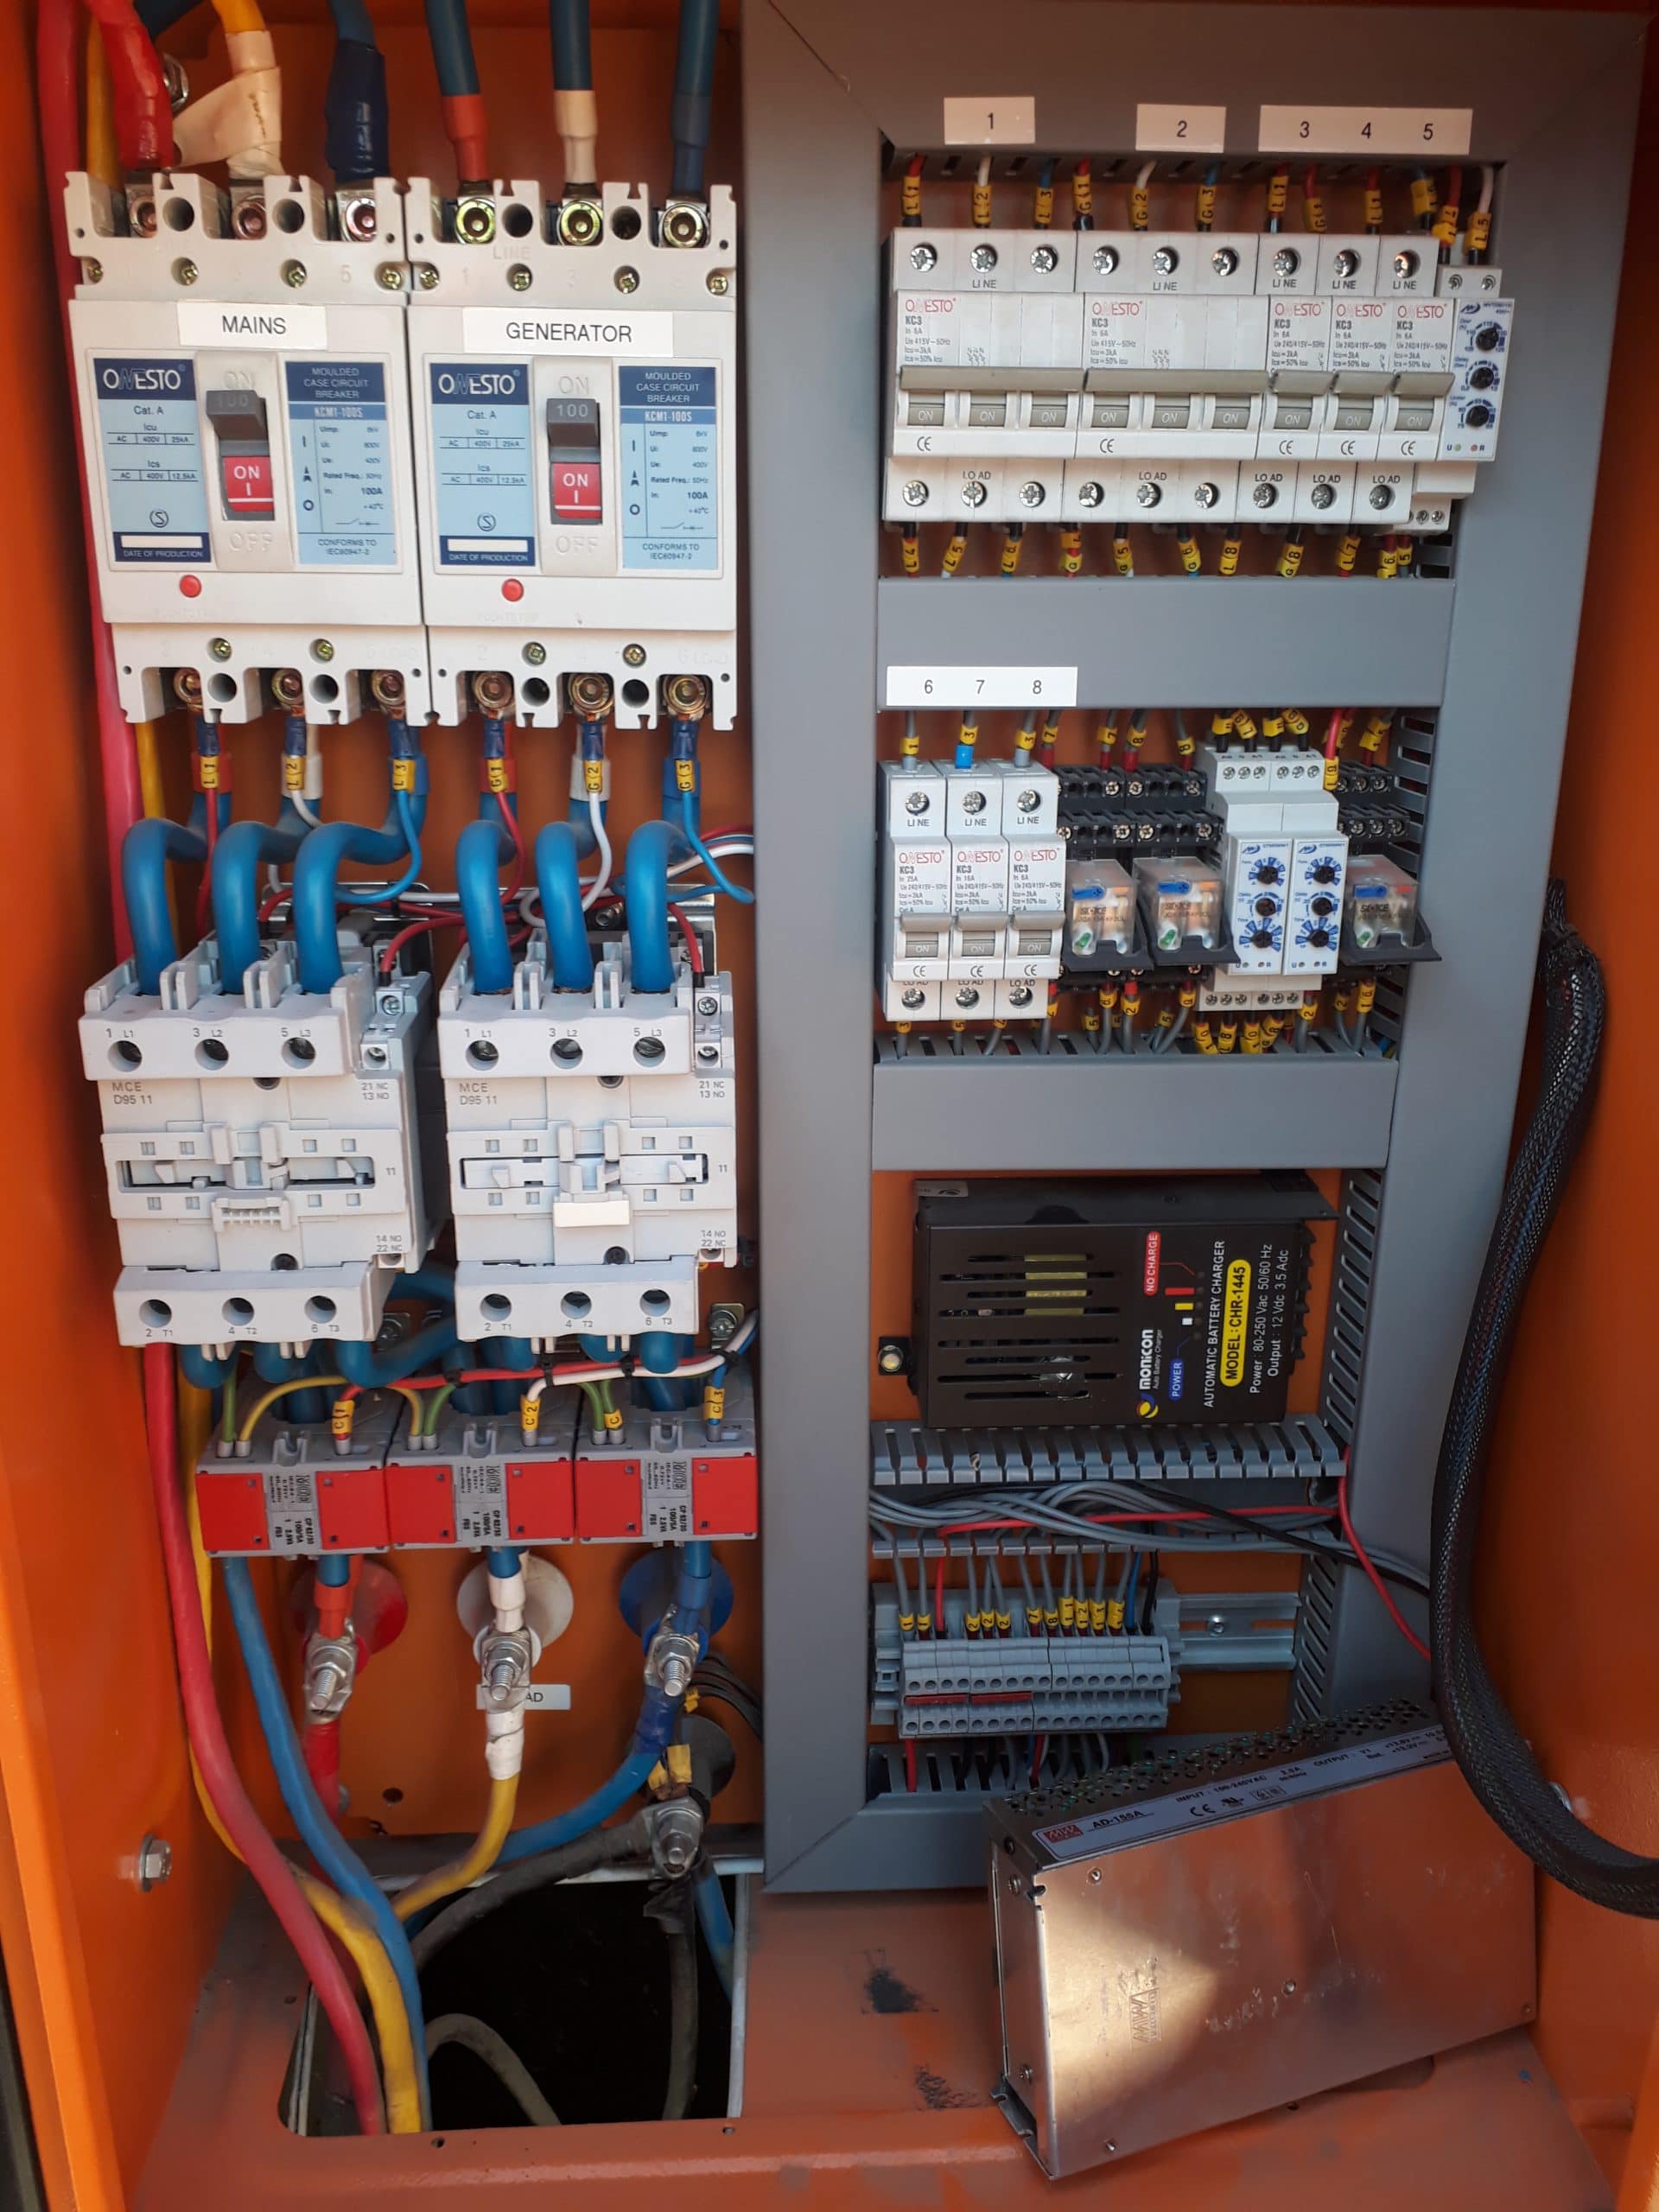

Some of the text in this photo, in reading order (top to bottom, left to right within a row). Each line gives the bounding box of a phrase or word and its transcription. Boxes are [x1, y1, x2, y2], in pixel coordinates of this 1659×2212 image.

[988, 112, 994, 130] 1
[1177, 120, 1188, 137] 2
[1300, 121, 1433, 140] 3 4 5
[905, 299, 953, 313] OESTO
[221, 315, 287, 335] MAINS
[1274, 319, 1291, 328] KC3
[505, 322, 632, 343] GENERATOR
[103, 368, 181, 390] ONESTO
[303, 378, 369, 388] CASE CIRCUIT
[438, 373, 516, 395] ONESTO
[558, 375, 590, 395] ON
[315, 390, 359, 398] BREAKER
[636, 383, 662, 391] CASE
[646, 394, 690, 403] BREAKER
[156, 406, 163, 415] A
[489, 410, 497, 419] A
[556, 404, 588, 418] 100
[918, 410, 934, 422] ON
[1223, 413, 1239, 424] ON
[233, 466, 259, 480] ON
[563, 473, 588, 487] ON
[228, 533, 275, 552] OFF
[556, 537, 598, 554] OFF
[924, 679, 1042, 695] 6 7 8
[899, 866, 914, 874] KC3
[957, 865, 972, 874] KC3
[106, 1028, 111, 1037] 1
[193, 1028, 200, 1037] 3
[281, 1027, 289, 1037] 5
[465, 1028, 470, 1037] 1
[549, 1027, 556, 1037] 3
[632, 1027, 640, 1037] 5
[111, 1082, 143, 1092] MCE
[459, 1083, 488, 1093] MCE
[699, 1080, 710, 1089] 21
[113, 1095, 153, 1105] D95 11
[460, 1096, 498, 1105] D95 11
[699, 1090, 710, 1098] 13
[385, 1167, 396, 1176] 11
[718, 1164, 728, 1173] 11
[1147, 1234, 1158, 1292] NO CHARGE
[1249, 1243, 1272, 1394] Power 80-250 Vac 50/60 Hz
[1268, 1249, 1288, 1376] Output 12 Vdc 3.5 Adc
[564, 1319, 572, 1328] 4
[645, 1317, 652, 1325] 6
[1204, 1241, 1224, 1408] AUTOMATIC BATTERY CHARGER
[1225, 1267, 1245, 1380] MODEL CHR-1445
[146, 1329, 153, 1338] 2
[227, 1327, 235, 1336] 4
[311, 1324, 318, 1332] 6
[1155, 1329, 1164, 1352] Charger
[1139, 1330, 1154, 1389] monicon
[1154, 1354, 1162, 1375] Battery
[1172, 1363, 1182, 1397] POWER
[525, 1692, 543, 1702] AD
